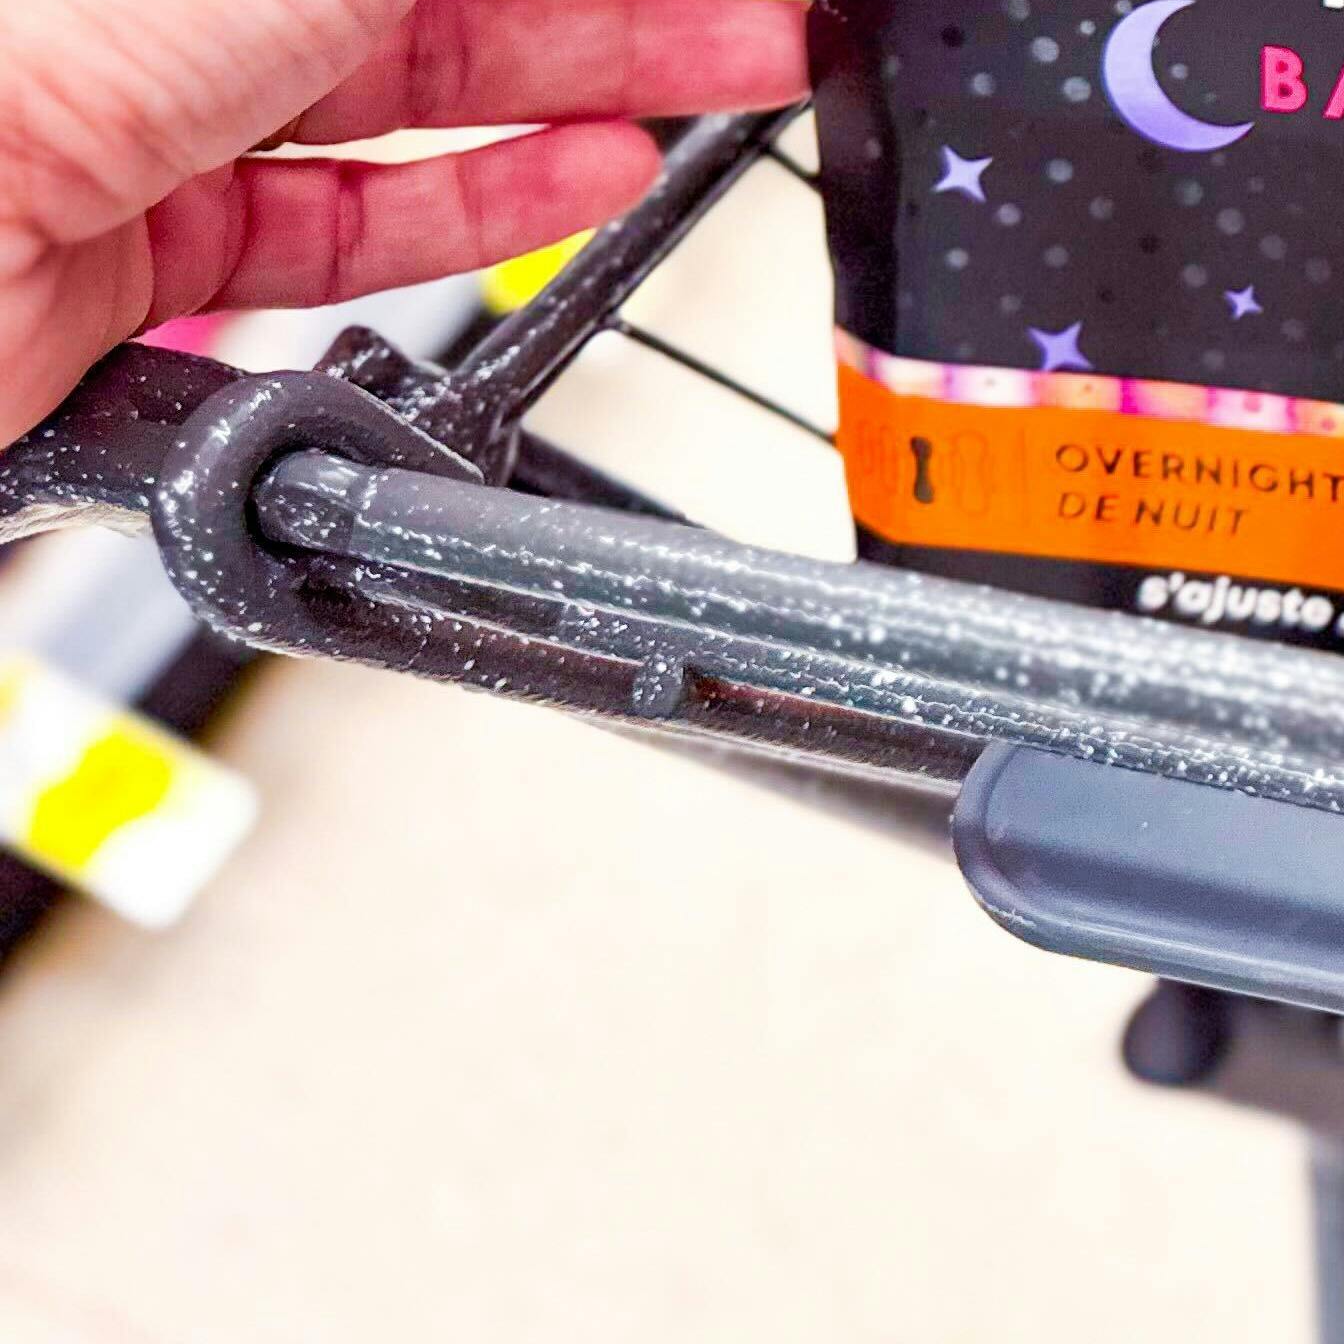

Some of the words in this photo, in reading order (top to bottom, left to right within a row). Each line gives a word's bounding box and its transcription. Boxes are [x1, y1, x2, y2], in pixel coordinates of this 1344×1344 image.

[1057, 492, 1120, 522] DE
[1134, 498, 1248, 536] NUIT
[1137, 571, 1335, 632] s'ajuste
